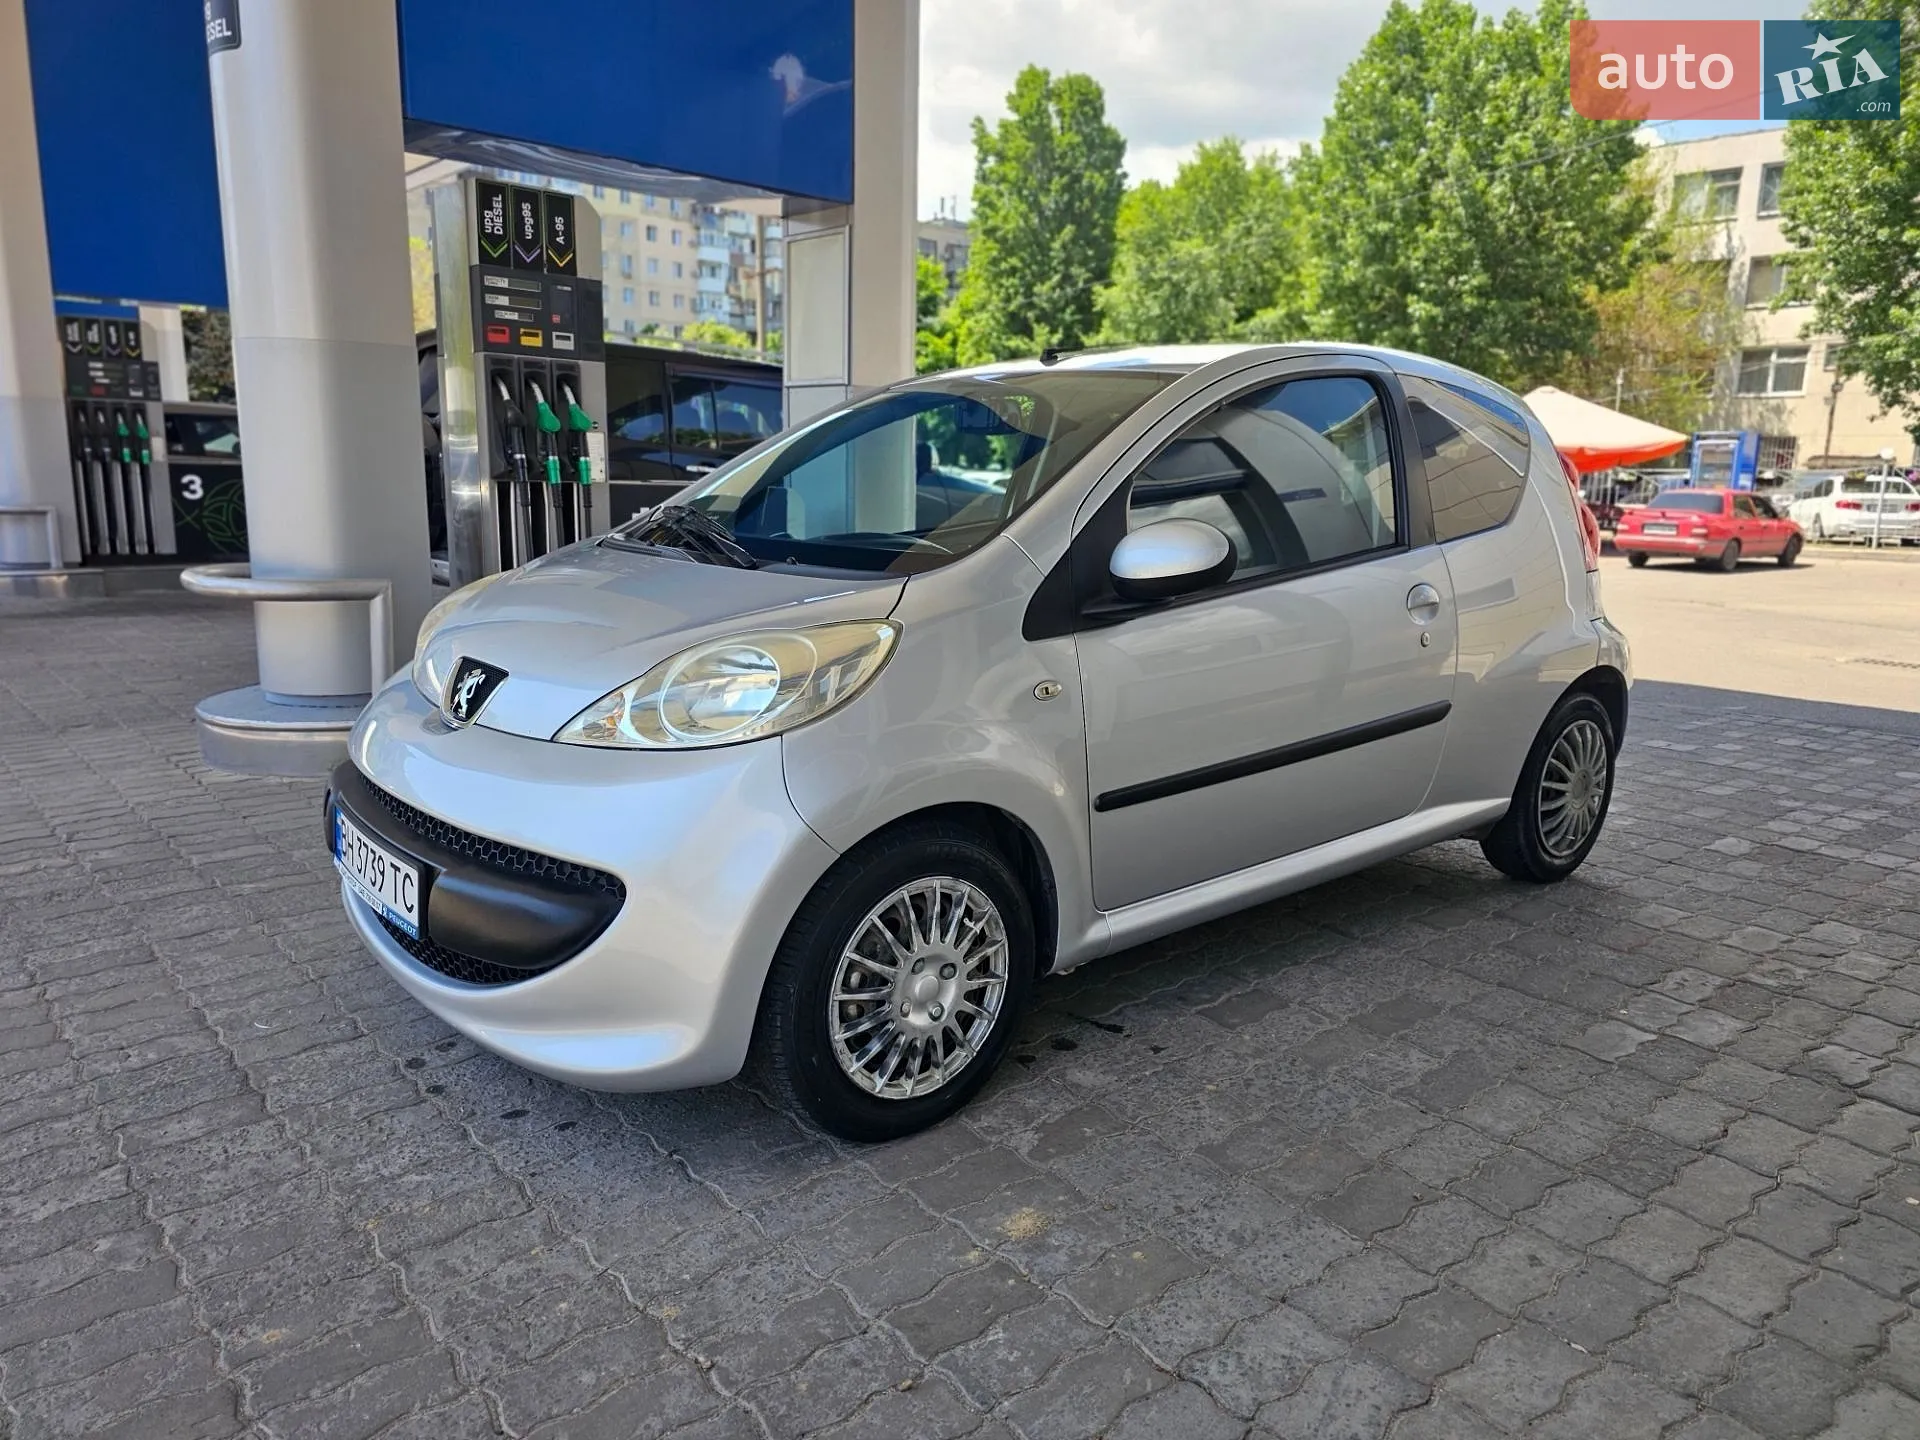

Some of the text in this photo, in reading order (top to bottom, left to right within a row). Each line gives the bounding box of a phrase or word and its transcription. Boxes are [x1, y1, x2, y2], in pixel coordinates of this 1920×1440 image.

[484, 210, 493, 233] upg
[492, 193, 504, 235] DIESEL
[521, 202, 534, 240] upg95
[554, 216, 565, 245] A-95
[181, 474, 204, 500] 3
[341, 818, 354, 867] BH
[356, 835, 386, 893] 3739
[390, 861, 415, 914] TC
